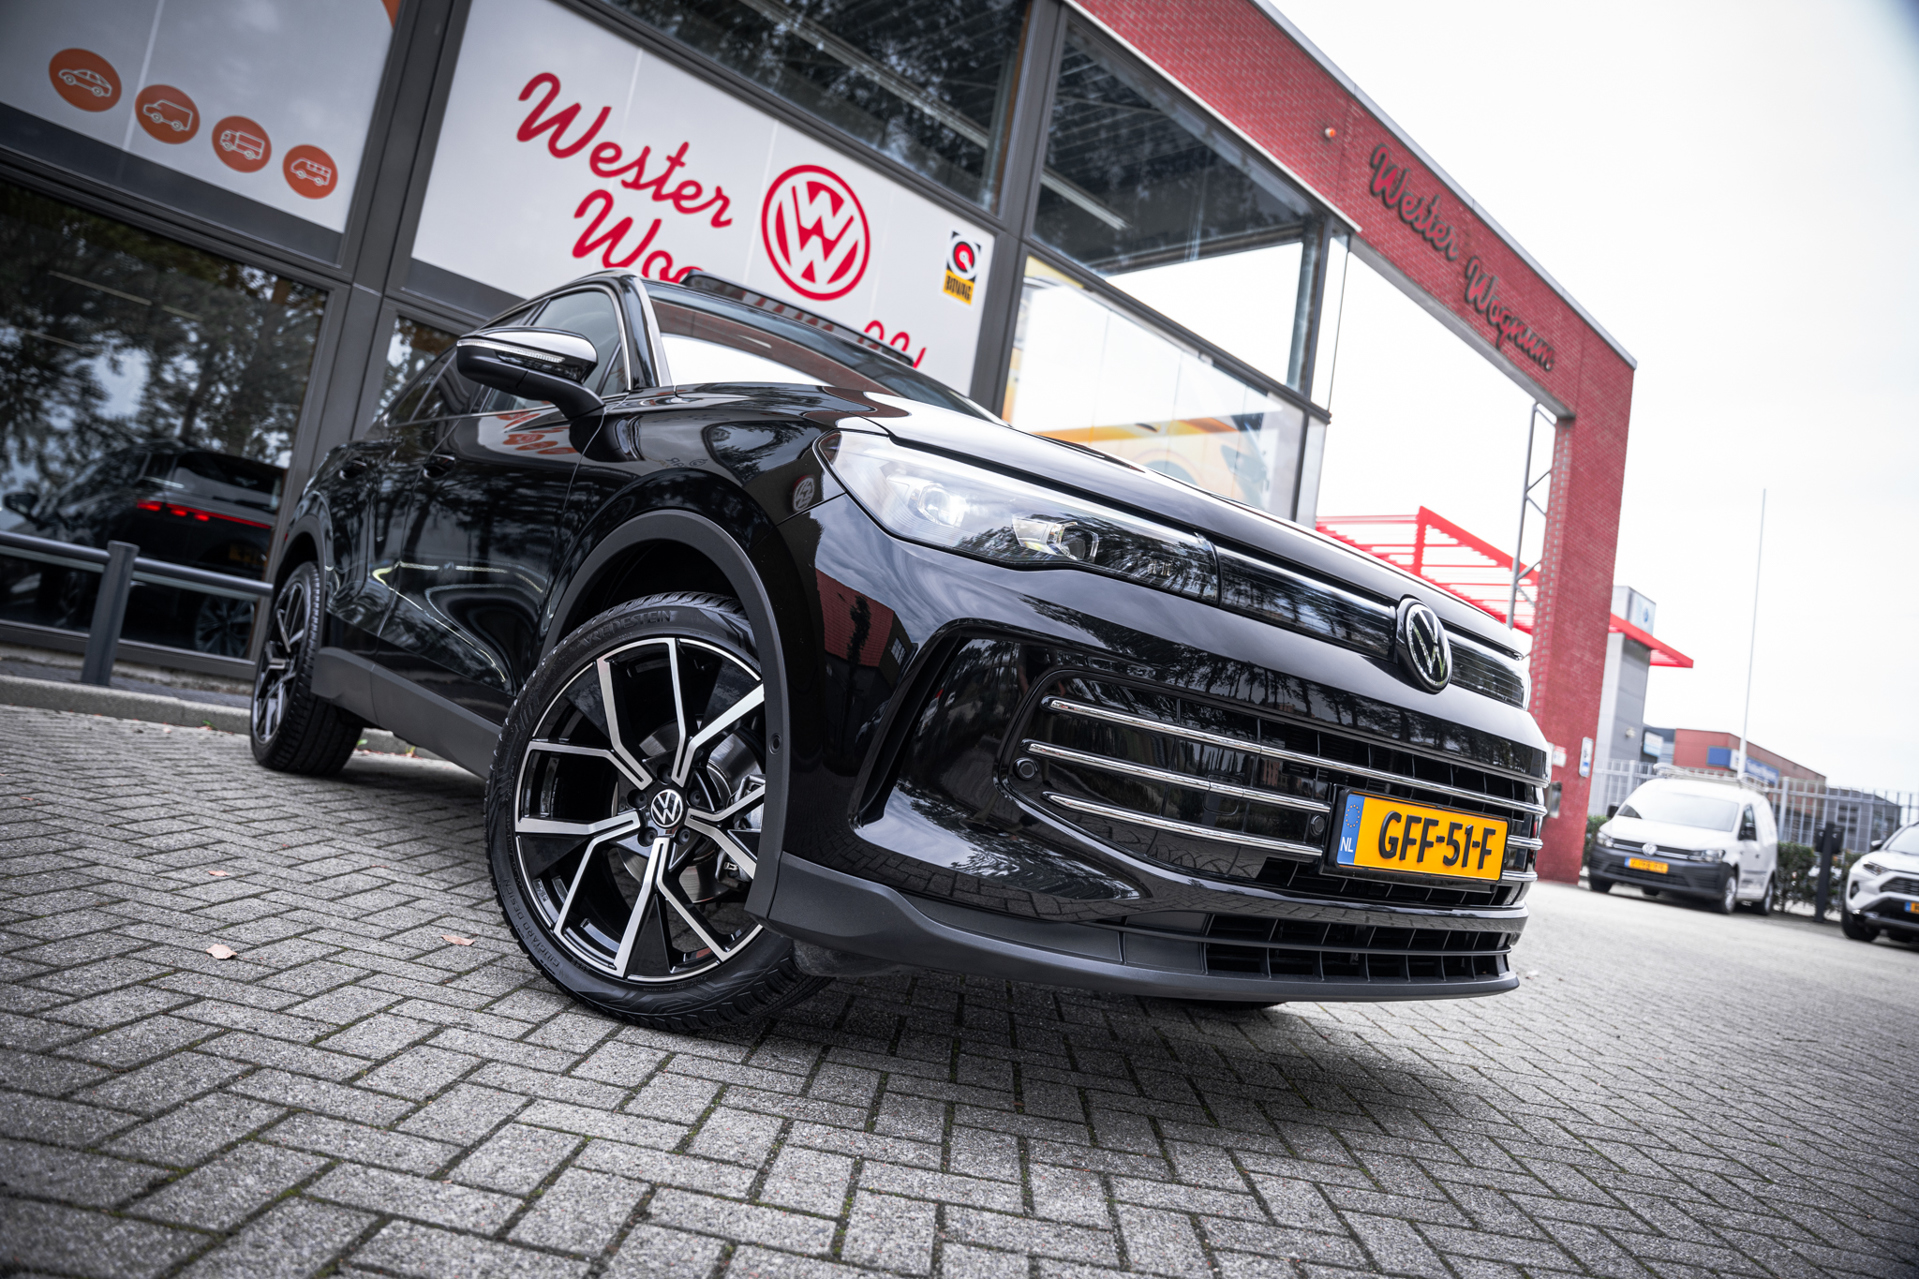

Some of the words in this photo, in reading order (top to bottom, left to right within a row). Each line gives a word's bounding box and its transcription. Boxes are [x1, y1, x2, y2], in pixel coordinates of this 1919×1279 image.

[516, 72, 733, 228] Wester
[1370, 143, 1459, 261] Wester
[945, 274, 972, 301] BOVAG
[1340, 836, 1354, 853] NL
[1378, 810, 1496, 870] GFF-51-F
